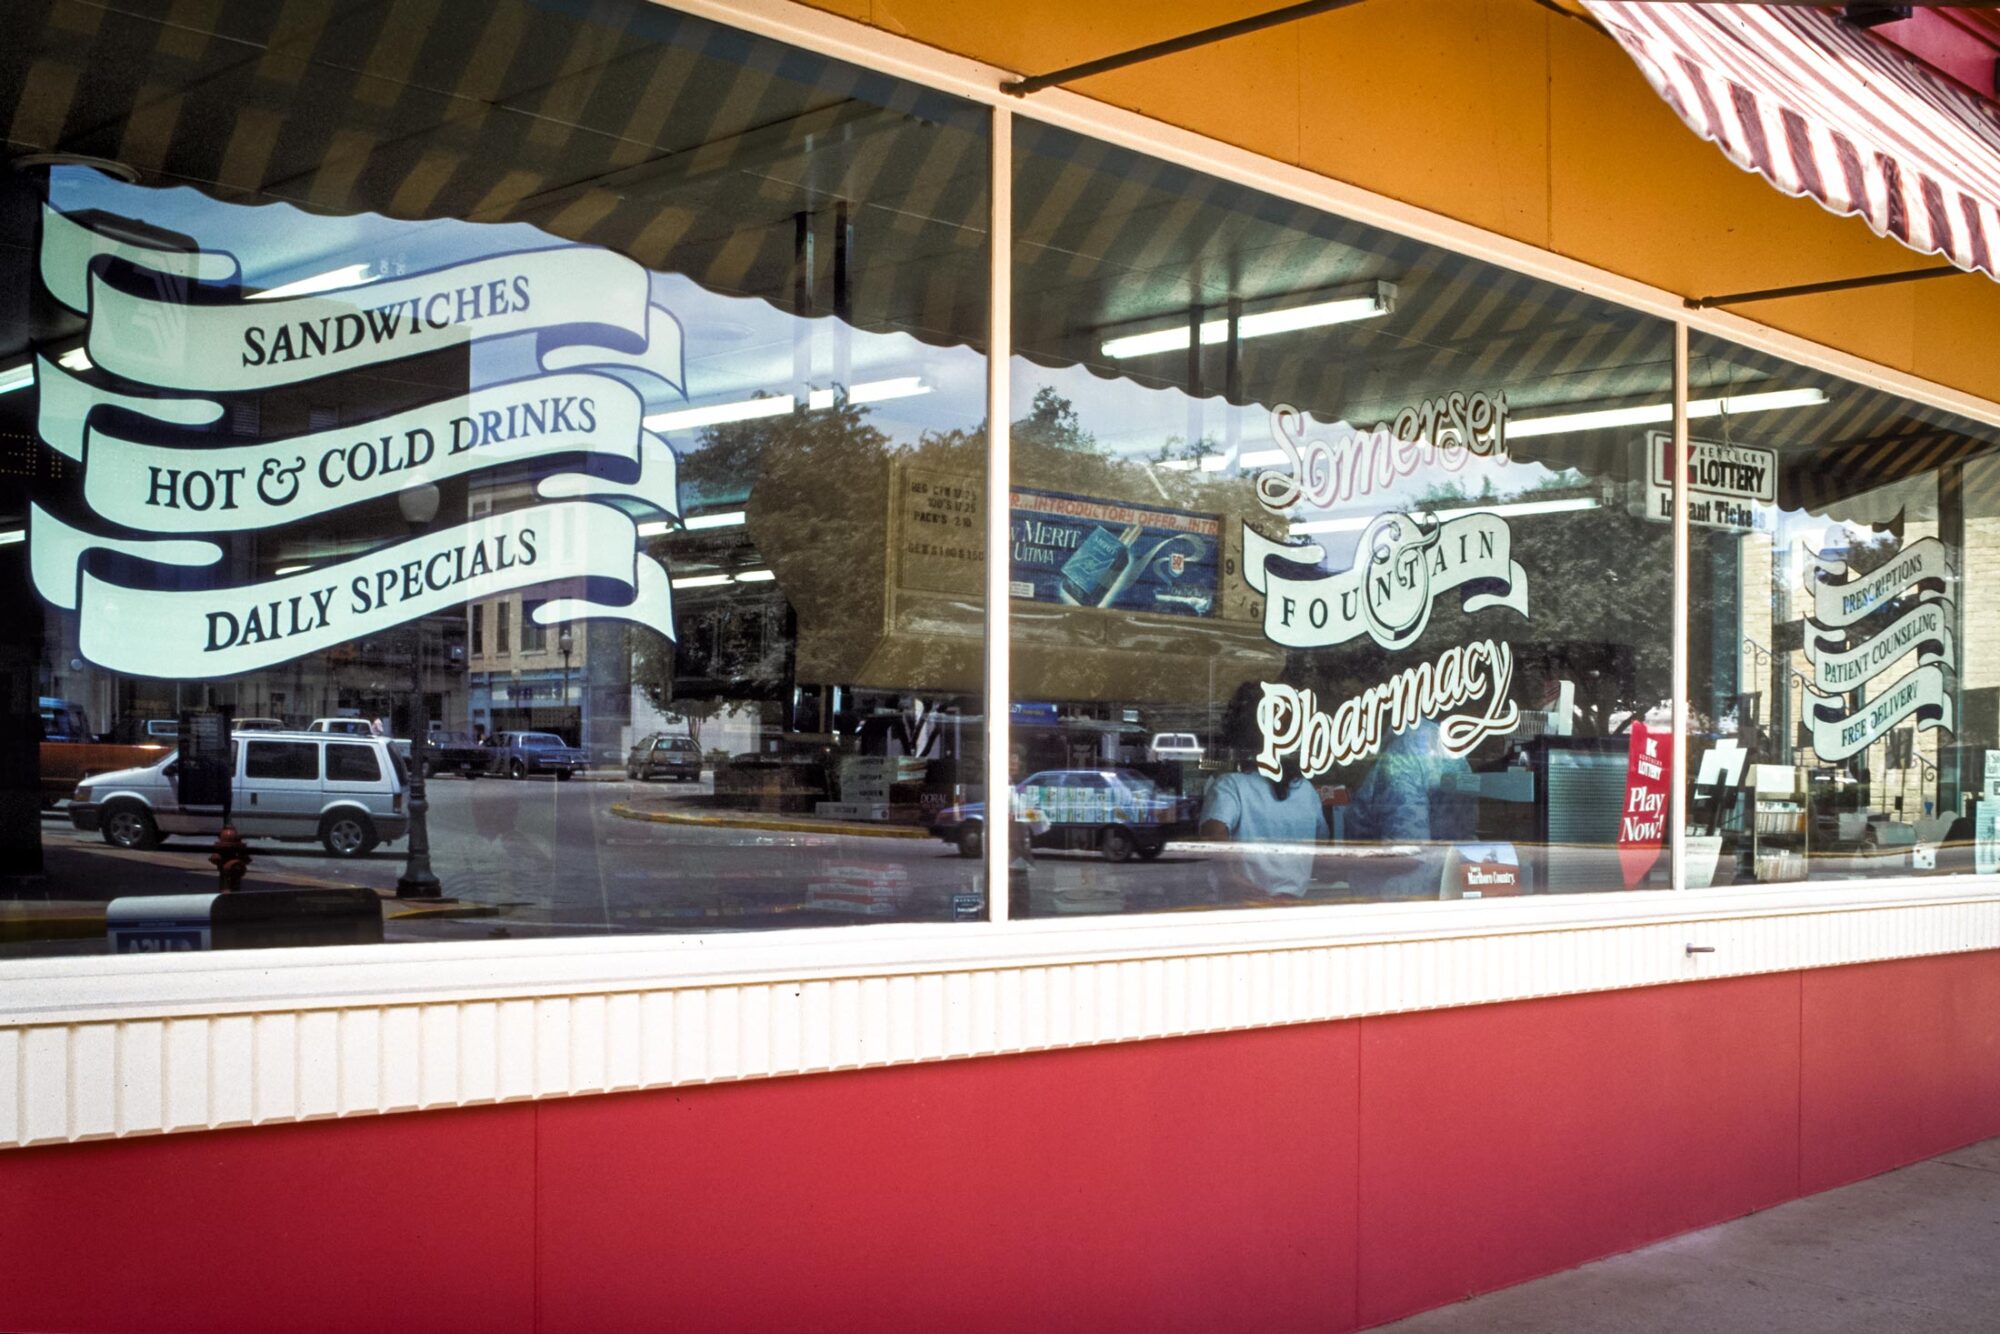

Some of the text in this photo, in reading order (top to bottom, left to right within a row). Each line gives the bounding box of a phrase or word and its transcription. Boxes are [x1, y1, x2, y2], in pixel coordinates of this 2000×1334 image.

[242, 276, 531, 368] SANDWICHES
[146, 396, 597, 511] HOT & COLD DRINKS
[1256, 390, 1511, 508] Somerset
[1700, 459, 1765, 493] LOTTERY
[1022, 520, 1081, 548] MERIT
[1661, 493, 1766, 528] Inant Tickets
[204, 528, 537, 652] DAILY SPECIALS
[1225, 559, 1235, 576] 9
[1281, 528, 1496, 630] FOUNTAIN
[1842, 554, 1923, 615] PRESCRIPTIONS
[1250, 602, 1259, 618] 6
[1824, 613, 1937, 684] PATIENT COUNSELING
[1256, 639, 1519, 781] Pharmacy
[1841, 680, 1919, 748] FREE DELIVERY
[1619, 814, 1664, 843] Now!
[1628, 786, 1665, 819] Play
